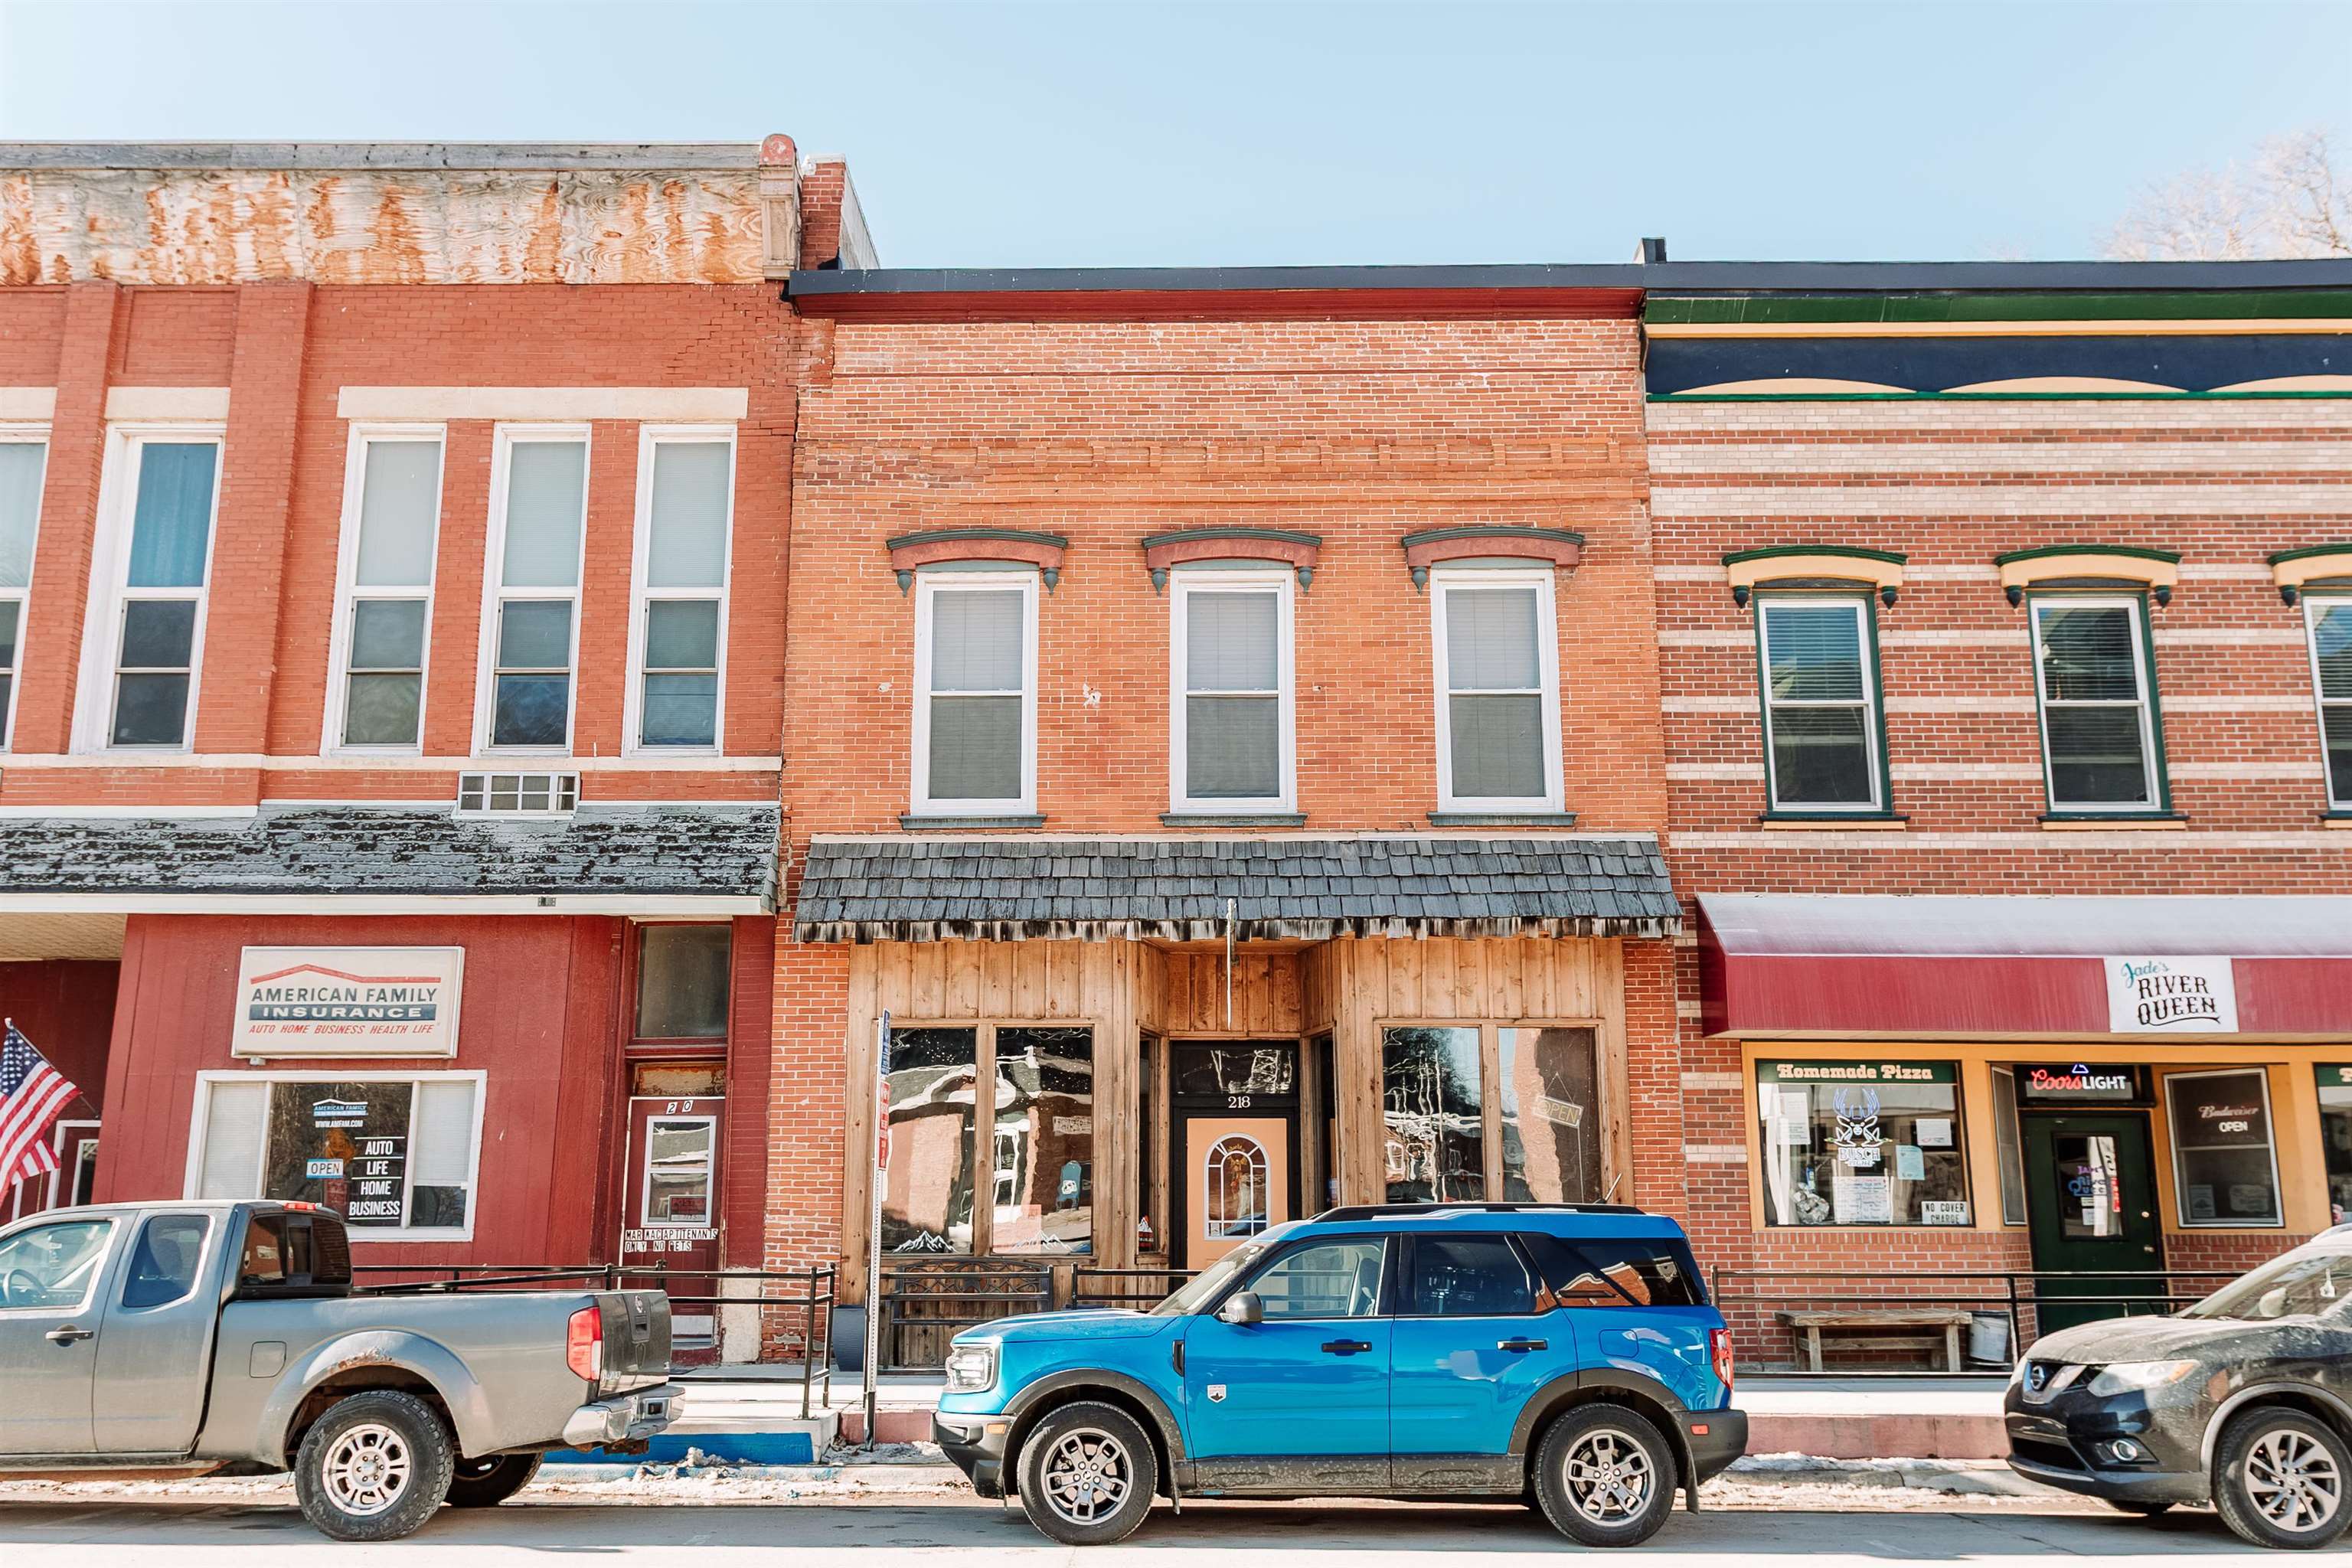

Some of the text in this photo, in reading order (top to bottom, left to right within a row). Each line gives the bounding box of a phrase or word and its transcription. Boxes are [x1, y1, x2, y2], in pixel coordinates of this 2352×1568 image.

[2121, 961, 2171, 988] Jade's
[2138, 975, 2208, 999] RIVER
[251, 988, 437, 1002] AMERICAN FAMILY
[263, 1008, 422, 1018] INSURANCE
[2138, 997, 2221, 1026] QUEEN
[249, 1024, 434, 1034] AUTO HOME BUSINESS HEALTH LIFE
[1776, 1064, 1933, 1079] Homemade Pizza
[2031, 1070, 2126, 1090] Coors LIGHT
[1228, 1096, 1250, 1109] 218
[1537, 1100, 1577, 1123] OPEN
[2199, 1106, 2259, 1119] Budweiser
[2219, 1121, 2249, 1133] OPEN
[364, 1140, 394, 1155] AUTO
[1838, 1148, 1881, 1161] BUSCH
[311, 1162, 340, 1174] OPEN
[366, 1161, 389, 1175] LIFE
[360, 1181, 392, 1196] HOME
[348, 1200, 400, 1217] BUSINESS
[1926, 1204, 1965, 1213] NO COVER
[1930, 1215, 1960, 1224] CHARGE
[655, 1241, 665, 1250] NO
